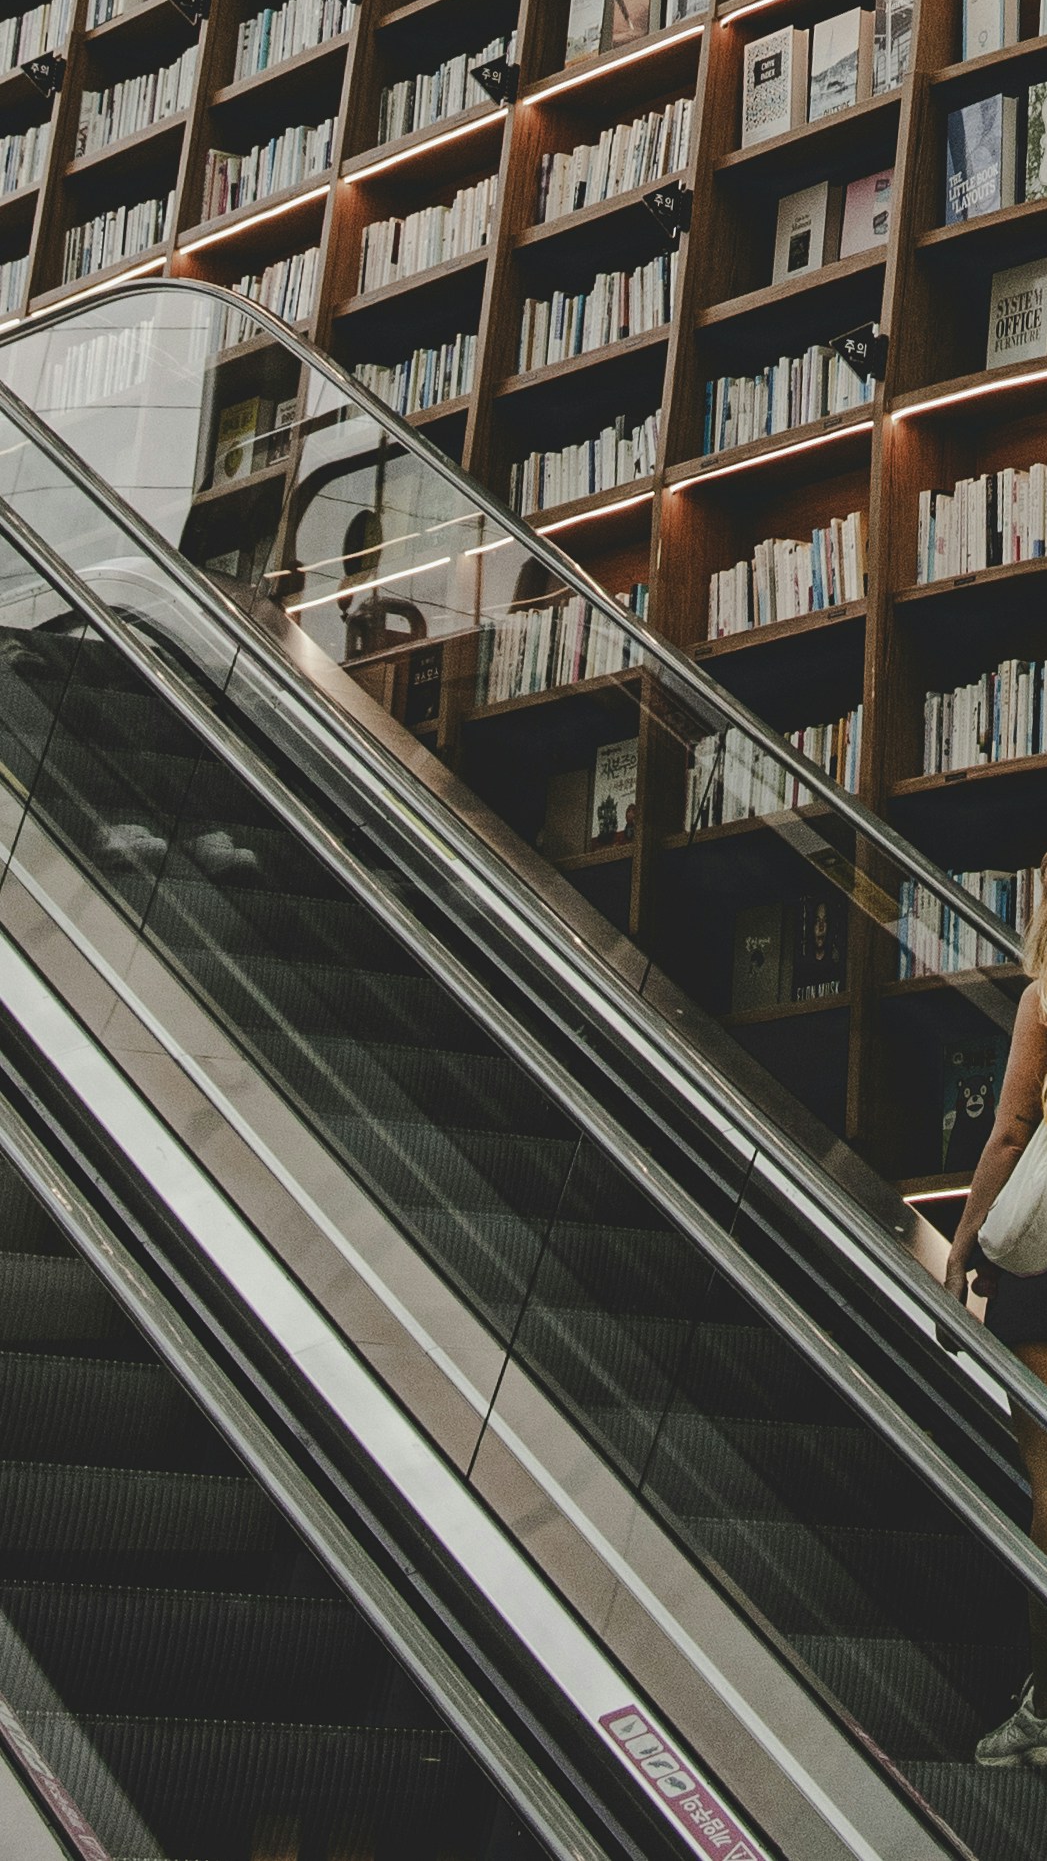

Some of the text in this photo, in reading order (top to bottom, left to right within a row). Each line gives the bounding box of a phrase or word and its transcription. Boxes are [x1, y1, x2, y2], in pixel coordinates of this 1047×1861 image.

[653, 193, 675, 211] 주의
[996, 289, 1043, 320] SYSTEM
[996, 307, 1042, 340] OFFICE
[844, 338, 868, 358] 주의
